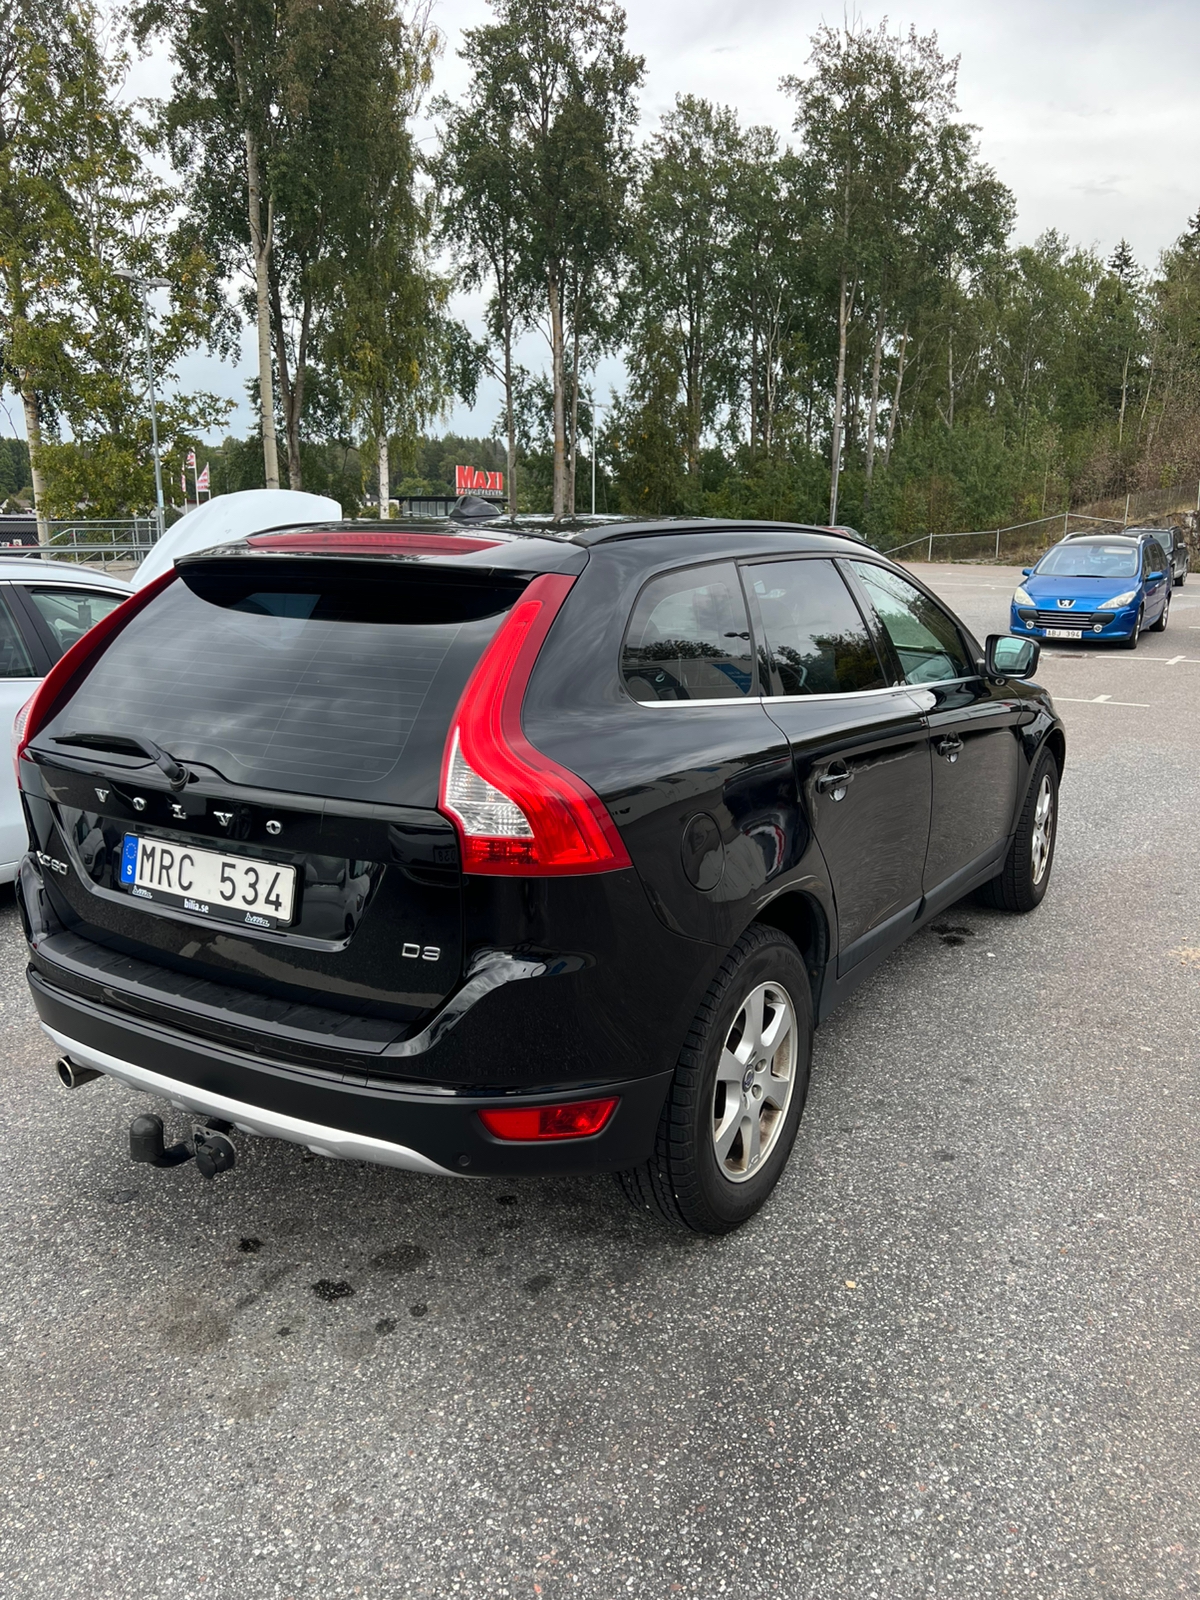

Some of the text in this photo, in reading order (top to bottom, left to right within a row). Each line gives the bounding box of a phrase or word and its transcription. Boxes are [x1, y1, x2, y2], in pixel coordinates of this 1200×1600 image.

[94, 787, 282, 835] VOLVO
[126, 865, 133, 876] S
[138, 843, 283, 912] MRC 534
[183, 898, 209, 914] bilia.se
[401, 942, 441, 961] D3
